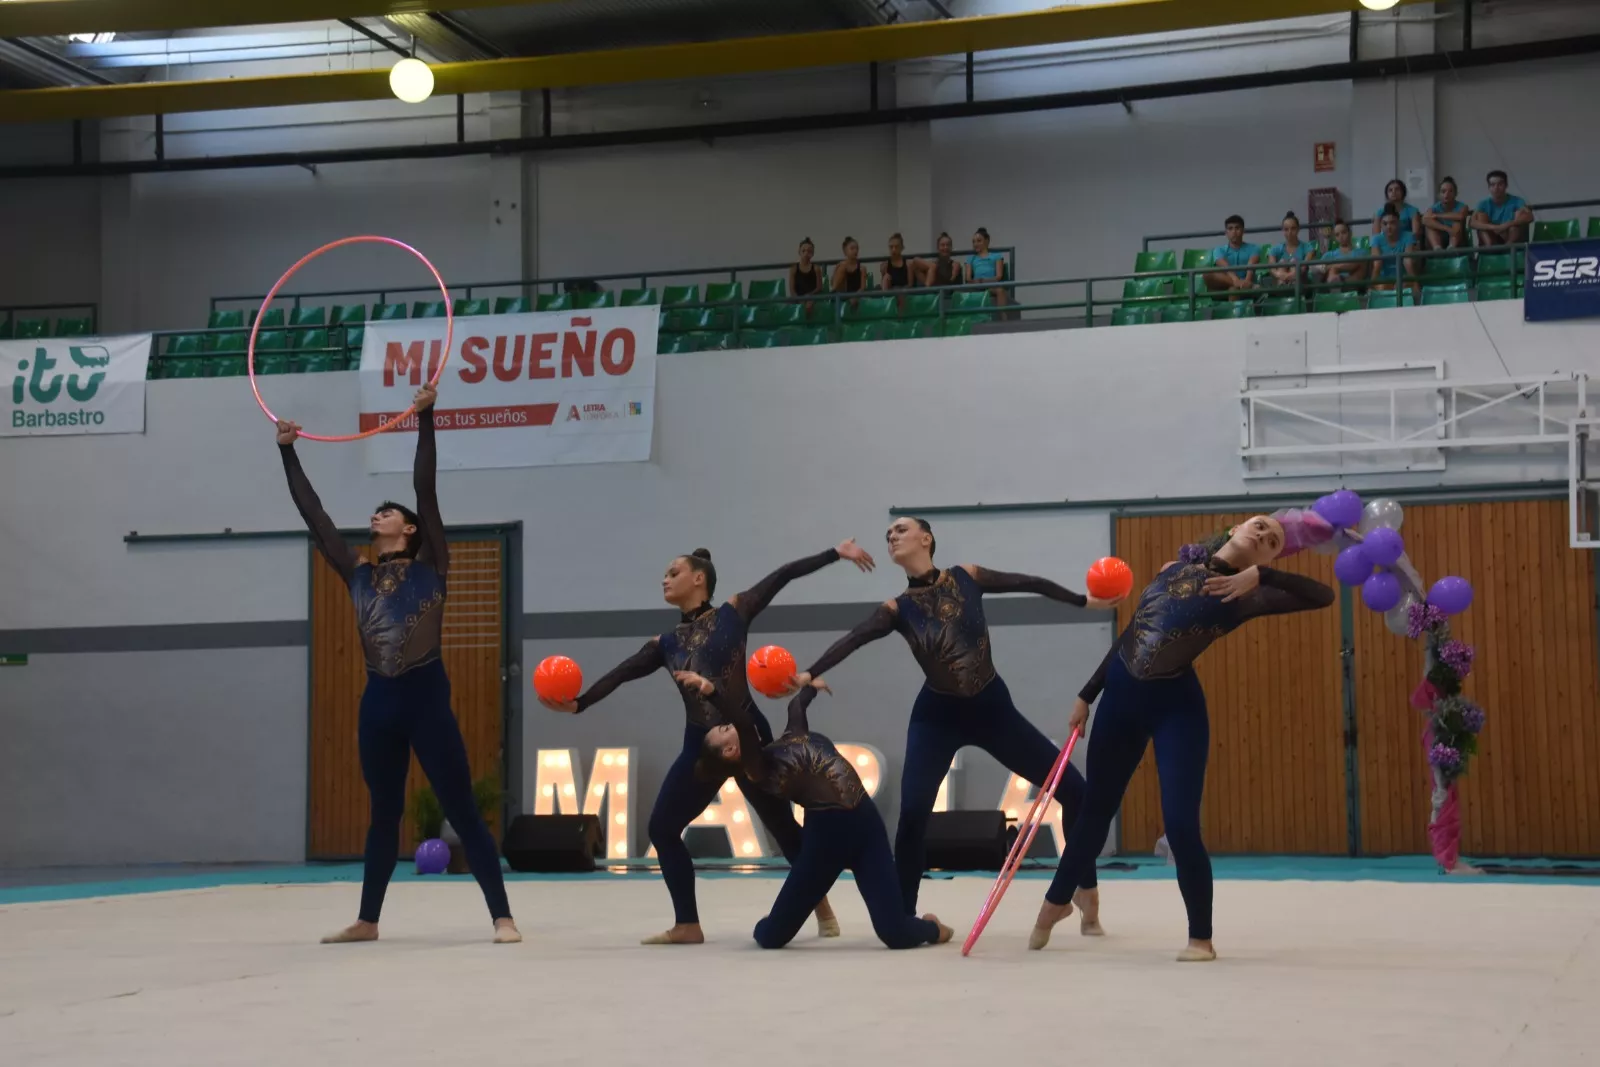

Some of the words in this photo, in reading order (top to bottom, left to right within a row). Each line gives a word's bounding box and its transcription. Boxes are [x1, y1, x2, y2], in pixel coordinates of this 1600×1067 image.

[1533, 257, 1600, 280] SER
[383, 340, 442, 387] MI
[458, 316, 636, 384] SUEÑO
[12, 409, 105, 427] Barbastro
[455, 411, 476, 426] tus
[480, 408, 527, 425] sueños
